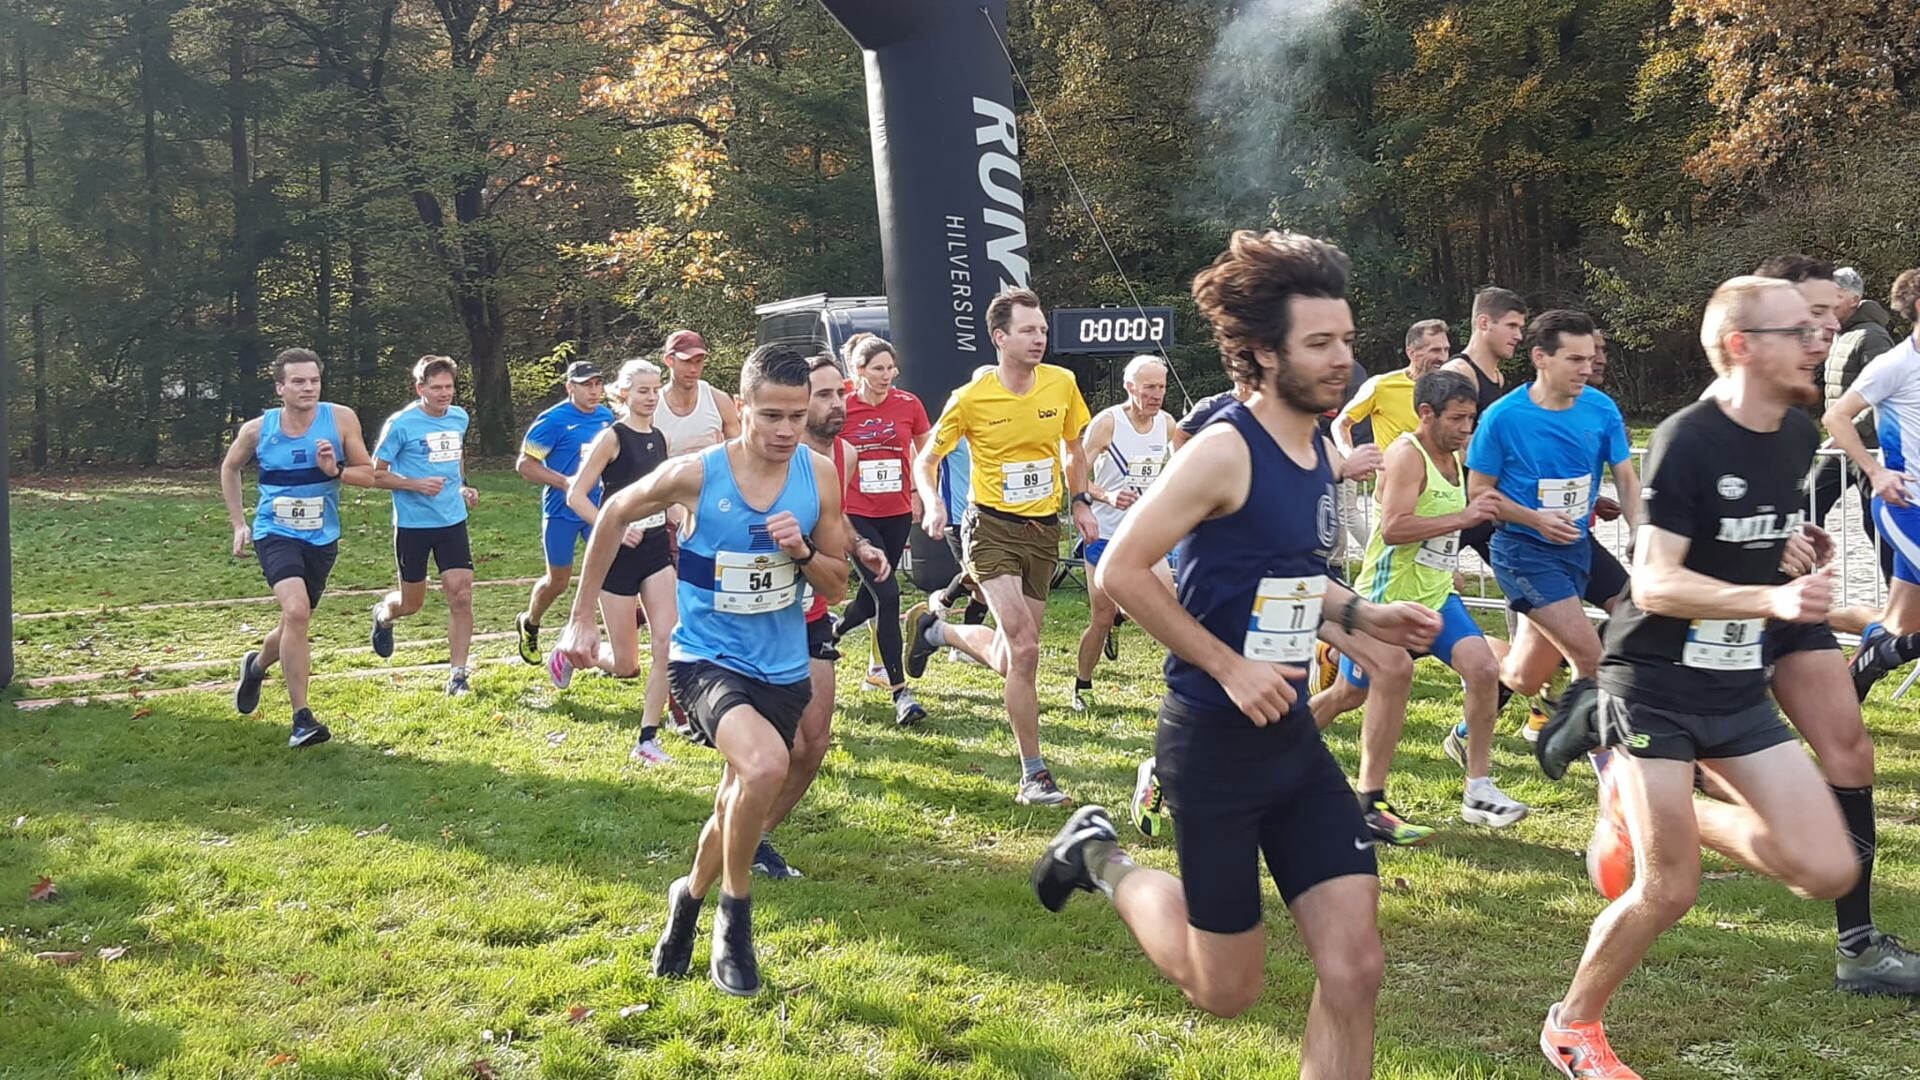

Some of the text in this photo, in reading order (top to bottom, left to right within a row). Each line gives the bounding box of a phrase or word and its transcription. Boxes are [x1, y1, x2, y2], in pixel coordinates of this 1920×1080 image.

[945, 215, 977, 352] HILVERSUM
[877, 469, 888, 480] 67
[1141, 465, 1152, 476] 65
[1024, 473, 1038, 487] 89
[1563, 491, 1577, 505] 97
[292, 507, 305, 518] 64
[749, 572, 772, 591] 54
